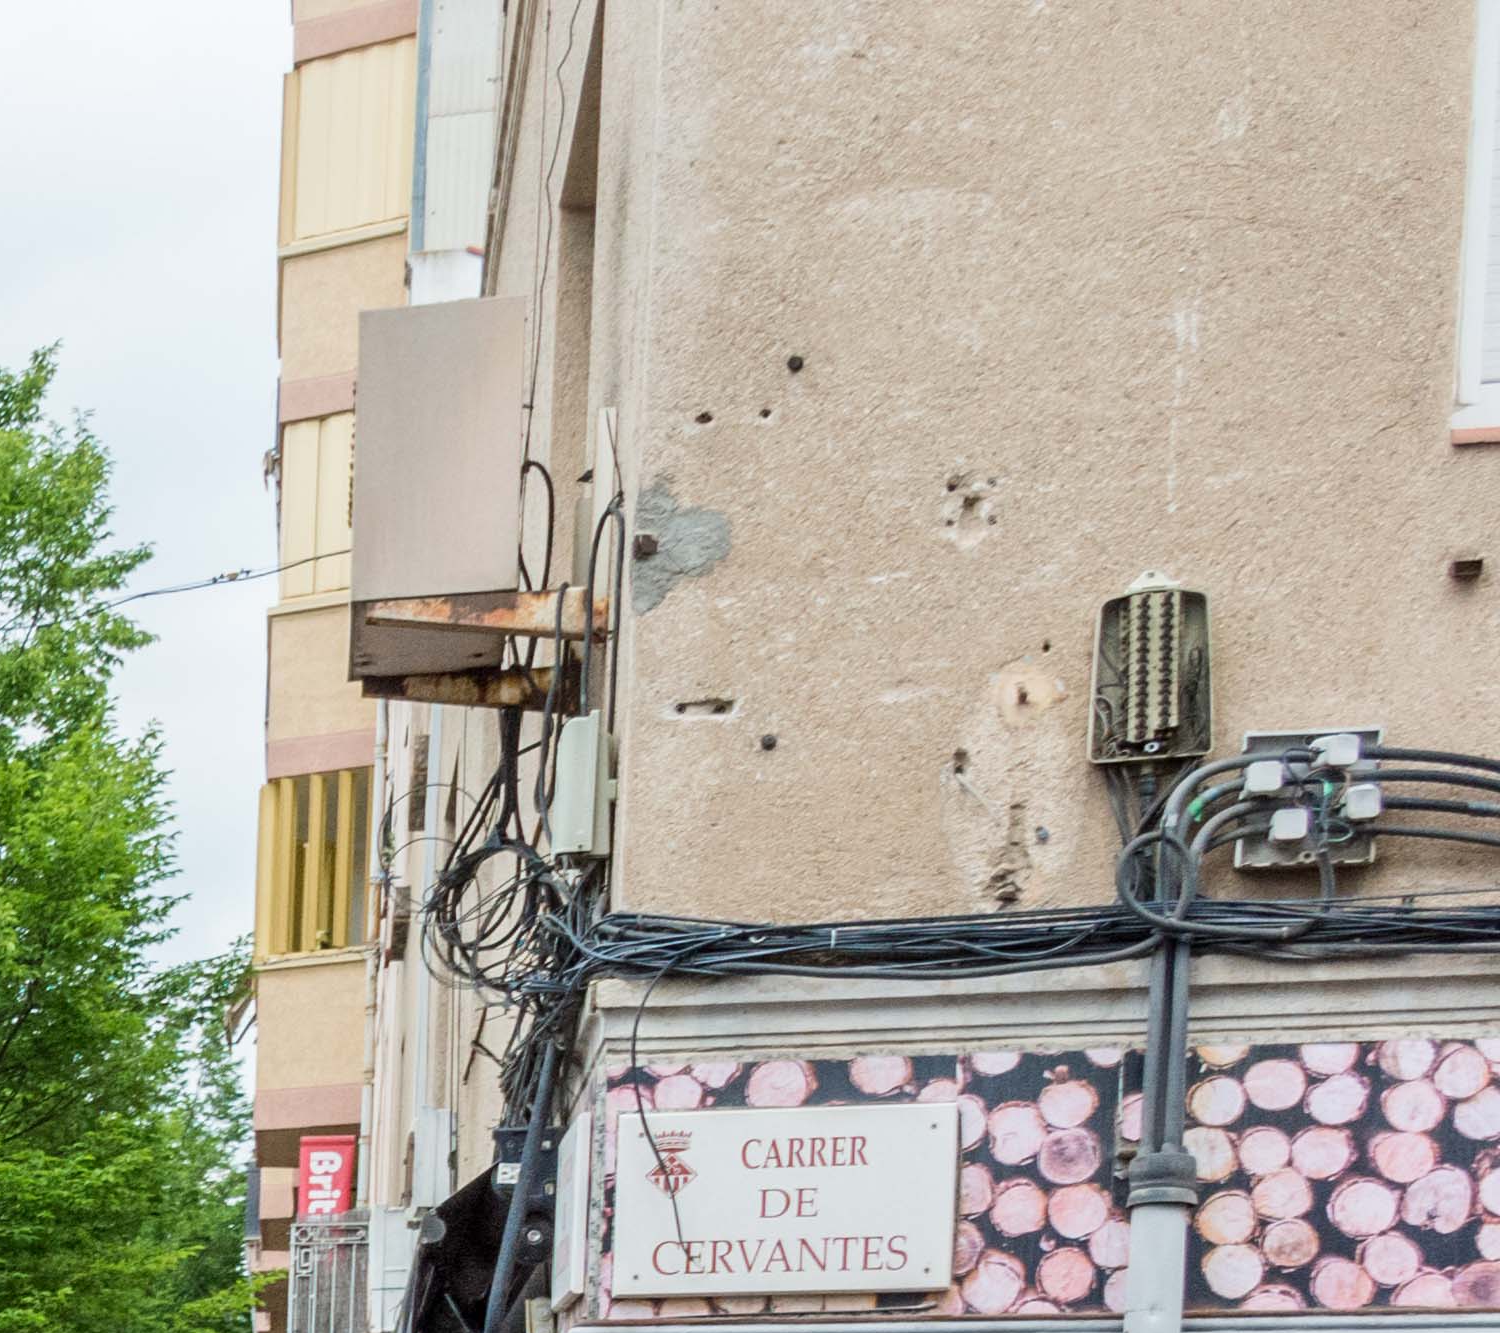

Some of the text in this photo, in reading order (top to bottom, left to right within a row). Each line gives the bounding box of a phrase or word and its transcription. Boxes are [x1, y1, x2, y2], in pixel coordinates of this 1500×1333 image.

[741, 1135, 869, 1170] CARRER
[759, 1187, 820, 1219] DE
[651, 1234, 910, 1276] CERVANTES
